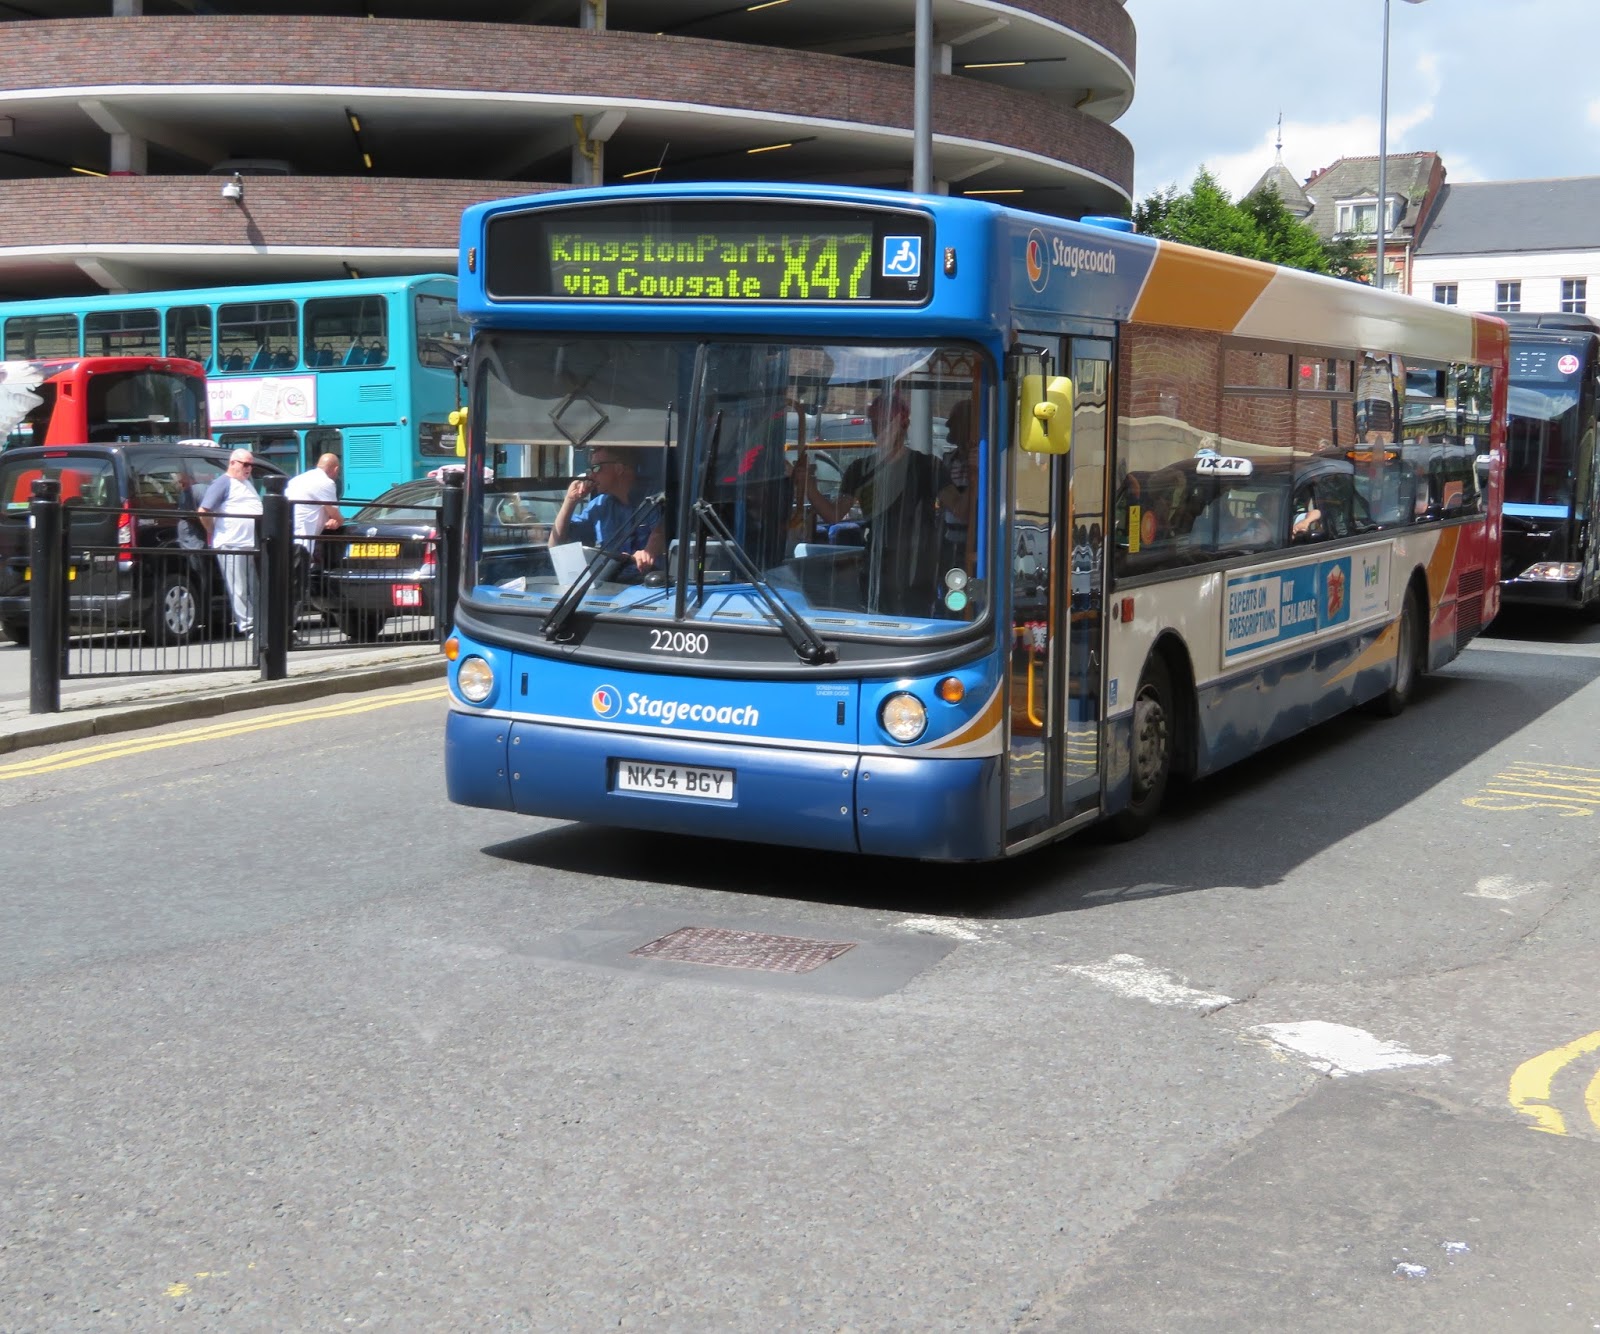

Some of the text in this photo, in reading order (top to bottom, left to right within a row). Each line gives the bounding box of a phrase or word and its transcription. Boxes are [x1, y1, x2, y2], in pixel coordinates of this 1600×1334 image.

[780, 235, 872, 298] X47
[1052, 237, 1116, 277] Stagecoach
[563, 268, 760, 297] via Cowgate
[1229, 586, 1267, 615] EXPERTS ON
[1282, 580, 1294, 603] NOT
[1281, 603, 1297, 626] MEAL
[650, 629, 709, 654] 22080
[626, 692, 759, 726] Stagecoach
[628, 765, 725, 793] NK54 BGY
